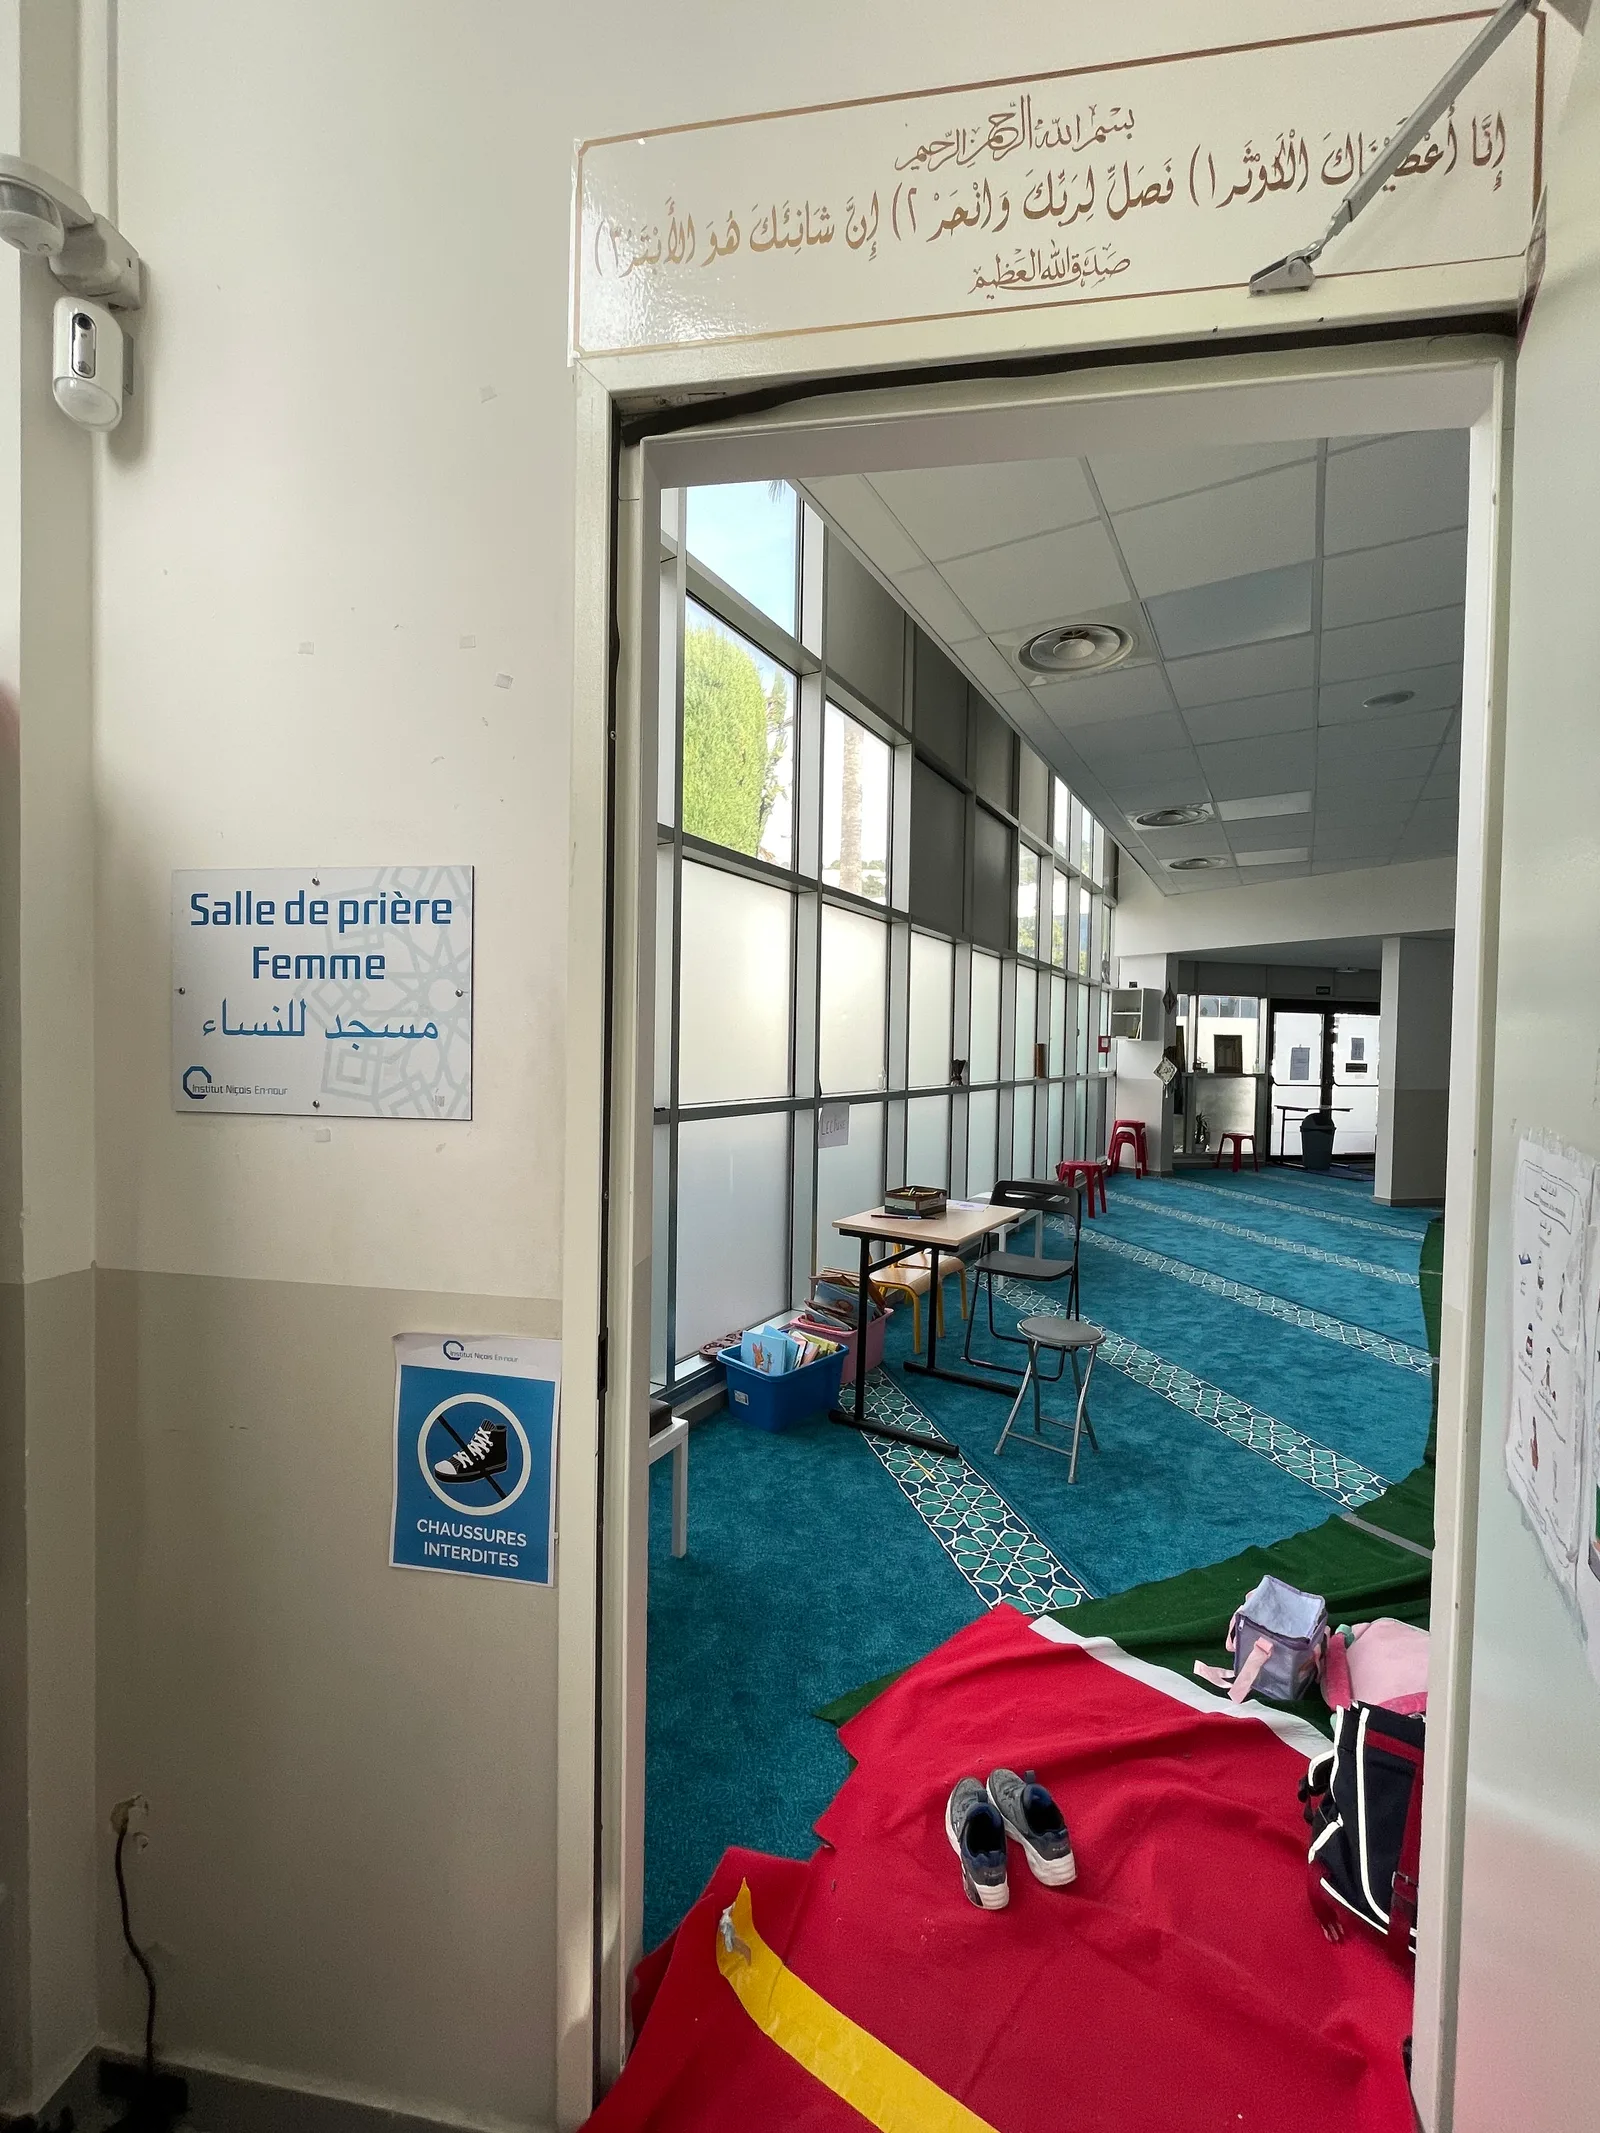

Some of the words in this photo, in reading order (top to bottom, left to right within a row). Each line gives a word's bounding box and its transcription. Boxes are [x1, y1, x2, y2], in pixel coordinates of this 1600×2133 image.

[190, 890, 276, 926] Salle
[284, 889, 330, 926] de
[338, 890, 453, 934] prière
[252, 946, 386, 980] Femme
[202, 997, 308, 1038] للنساء
[324, 1013, 440, 1051] مسجد
[192, 1084, 224, 1095] Institut
[225, 1085, 252, 1096] Niçois
[416, 1518, 528, 1548] CHAUSSURES
[423, 1541, 520, 1568] INTERDITES
